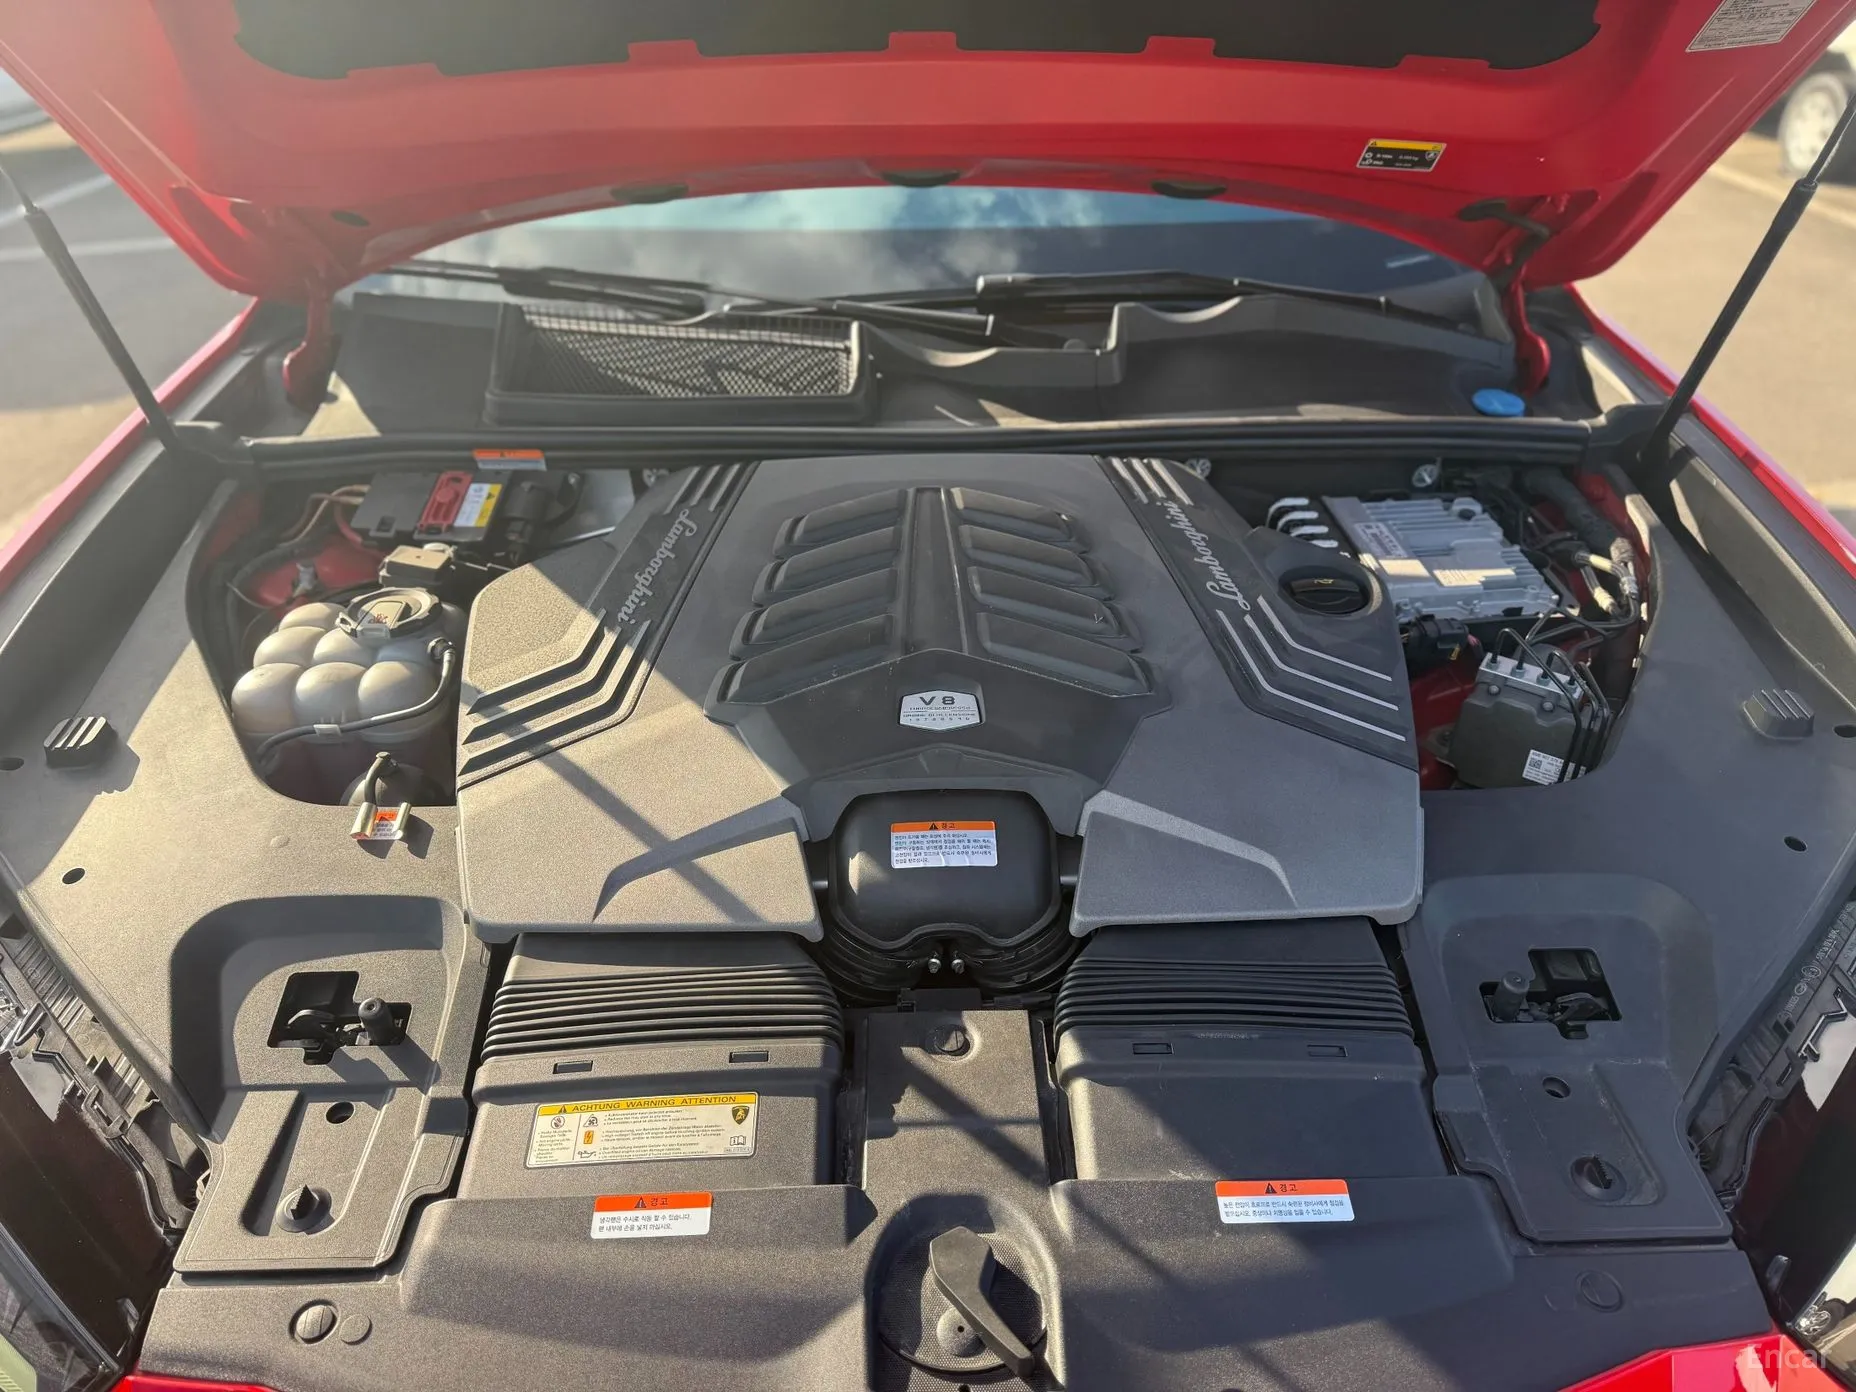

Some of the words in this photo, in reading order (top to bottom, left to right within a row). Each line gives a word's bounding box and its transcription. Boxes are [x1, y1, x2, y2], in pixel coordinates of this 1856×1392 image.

[617, 509, 698, 624] Lamborghini
[1156, 501, 1251, 611] Lamborghini
[572, 1102, 621, 1112] ACHTUNG
[626, 1099, 676, 1108] WARNING
[680, 1096, 737, 1105] ATTENTION
